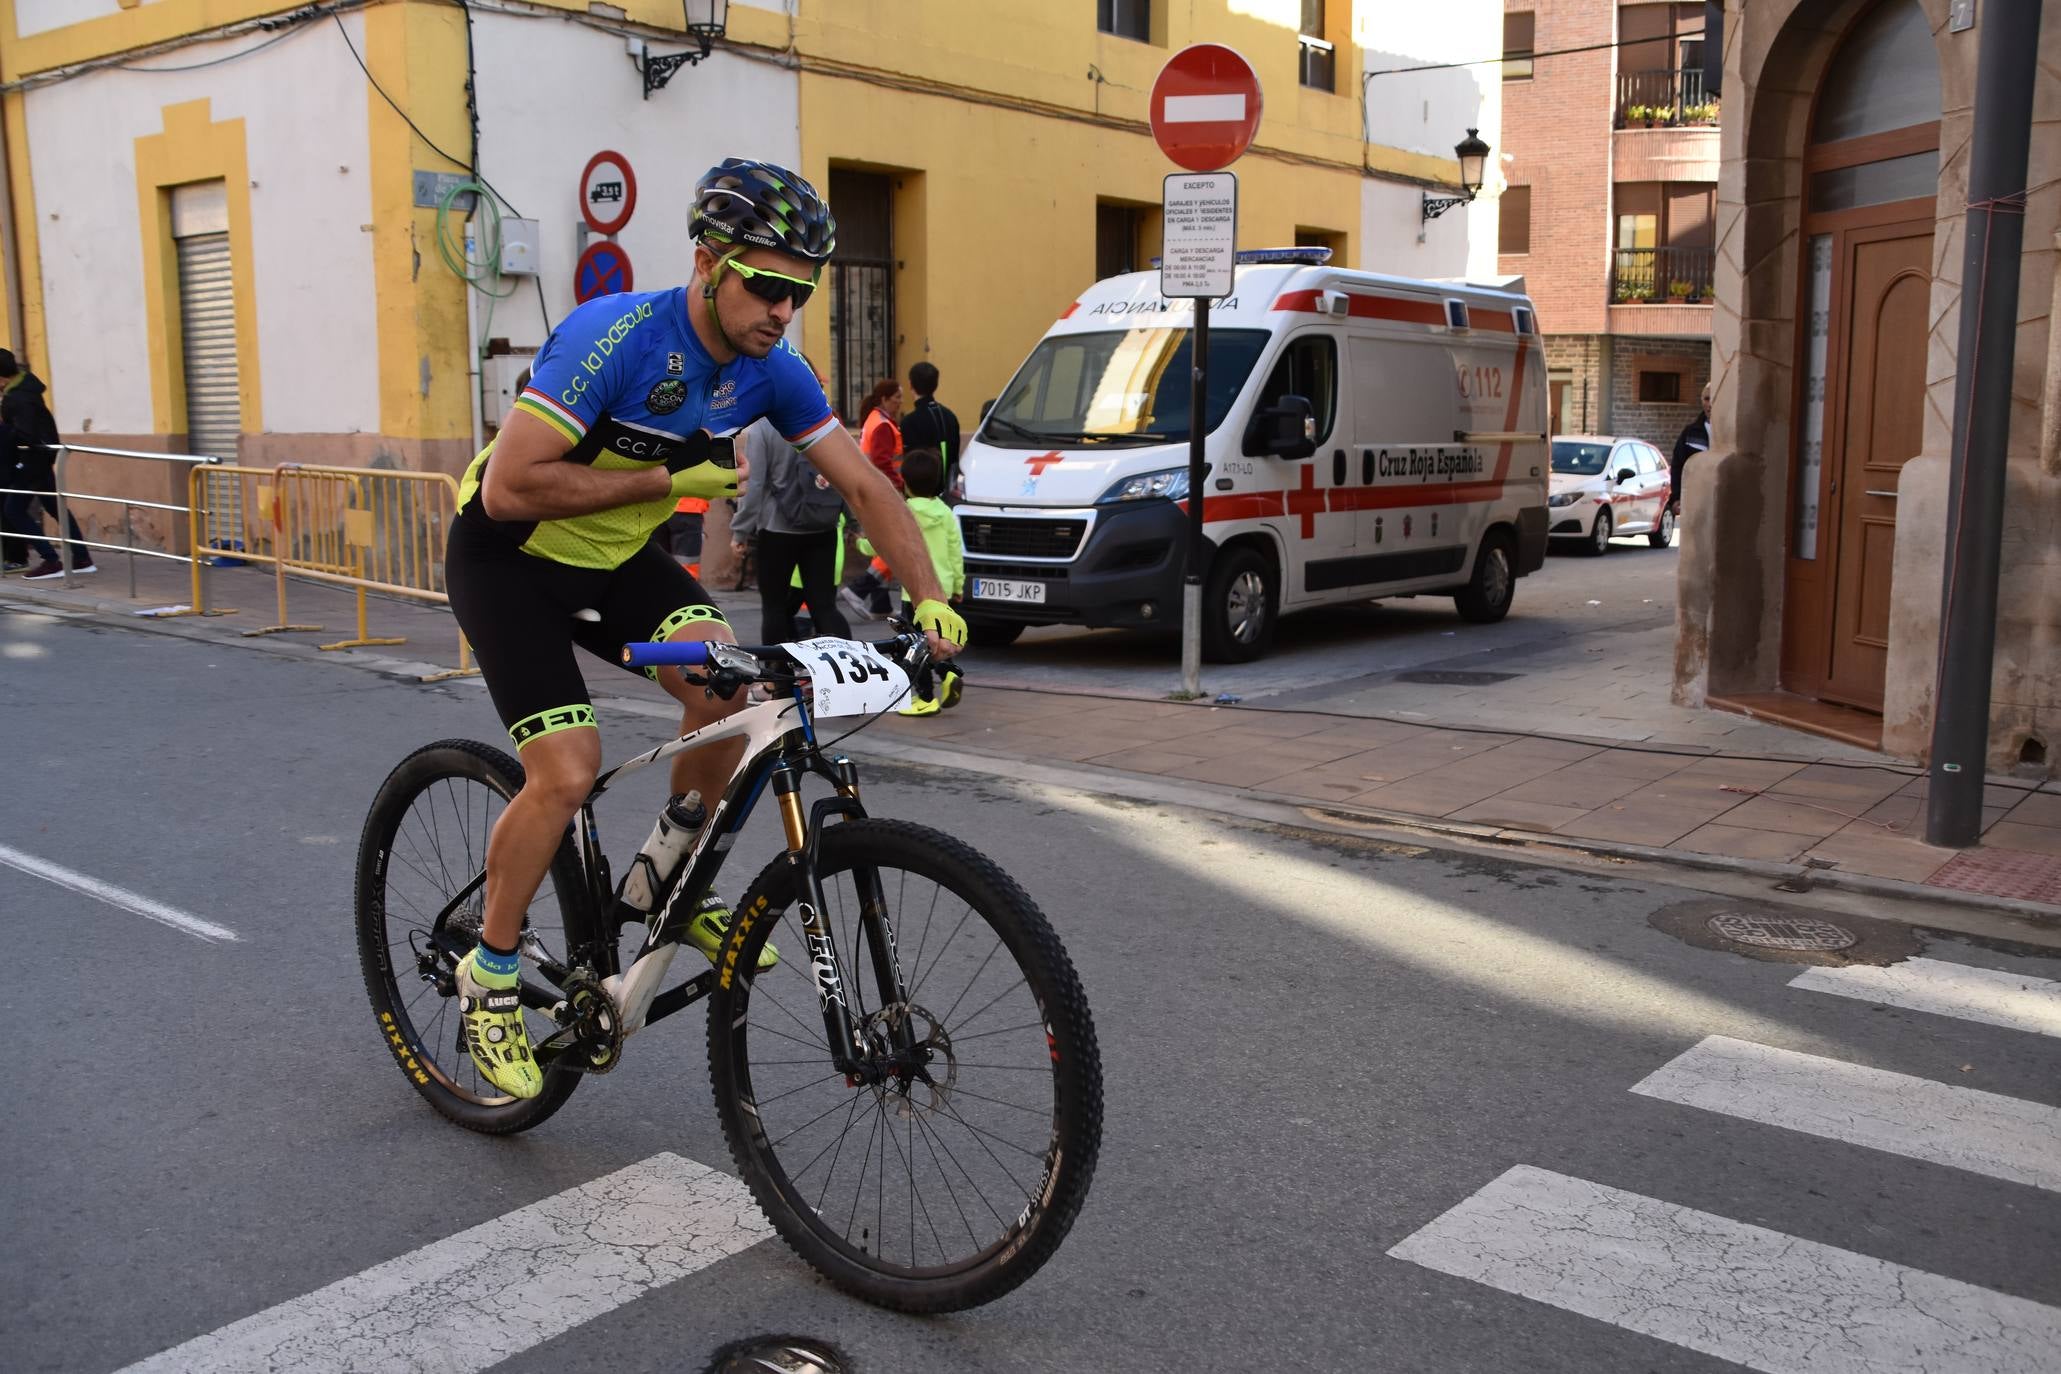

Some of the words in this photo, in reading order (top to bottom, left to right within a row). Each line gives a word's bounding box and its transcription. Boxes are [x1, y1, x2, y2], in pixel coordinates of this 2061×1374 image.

[1183, 181, 1215, 190] EXCEPTO
[702, 213, 735, 235] movistar
[1200, 215, 1231, 223] DESCARGA
[580, 351, 604, 376] la
[1475, 366, 1502, 398] 112
[1379, 448, 1408, 478] Cruz
[1408, 448, 1435, 482] Roja
[1436, 447, 1484, 482] Española
[980, 580, 1012, 597] 7015
[1016, 583, 1042, 600] JKP
[817, 650, 889, 684] 134
[719, 895, 769, 991] MAXXIS
[487, 995, 519, 1008] LUCK
[380, 1011, 430, 1085] MAXXIS
[1018, 1203, 1032, 1229] DT
[1029, 1168, 1051, 1209] SWISS
